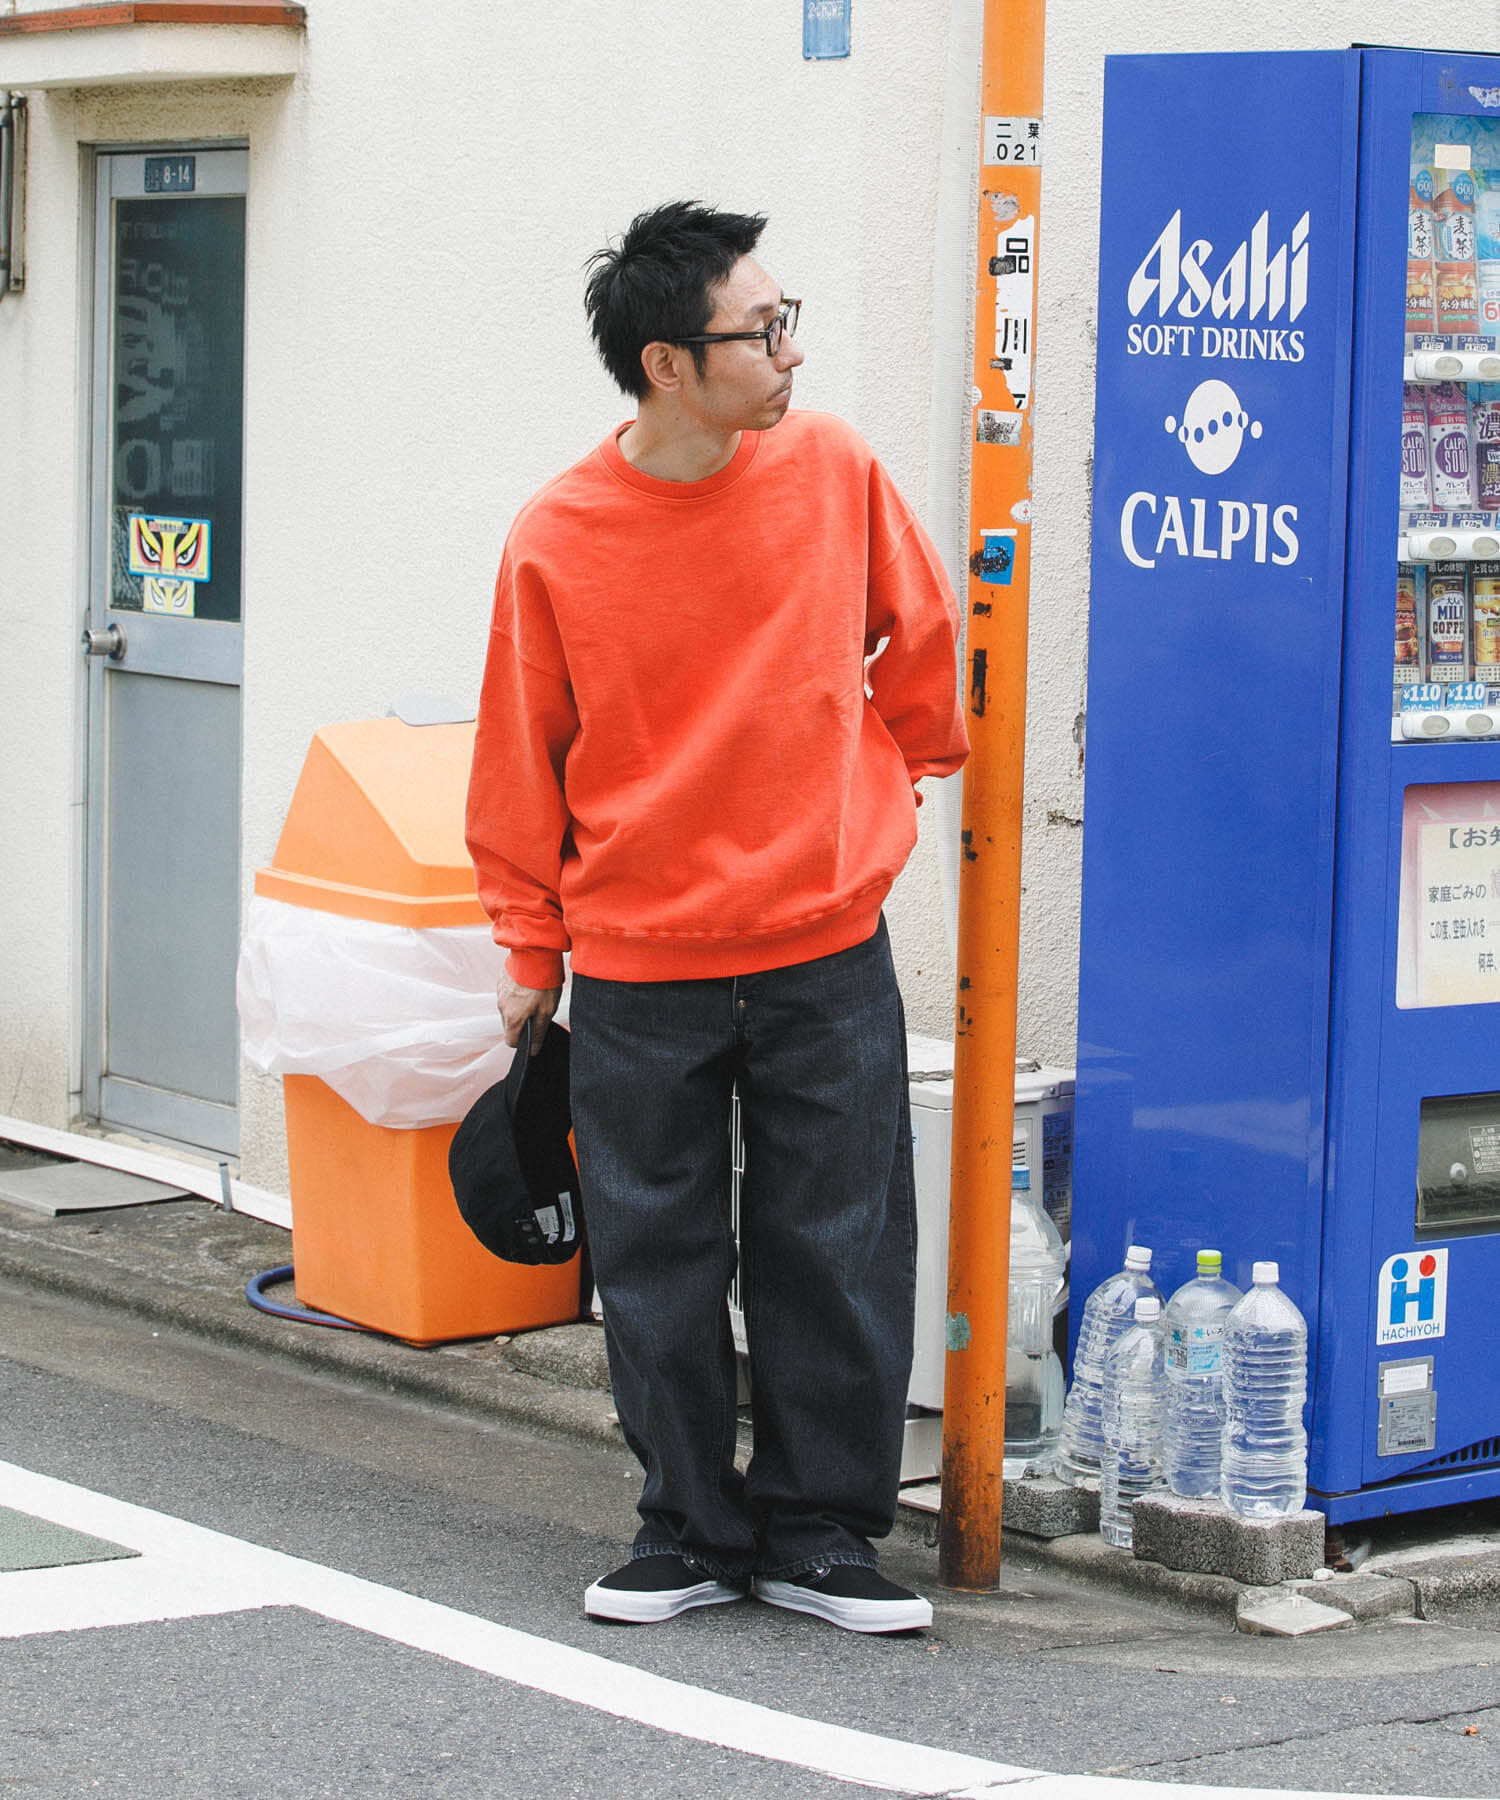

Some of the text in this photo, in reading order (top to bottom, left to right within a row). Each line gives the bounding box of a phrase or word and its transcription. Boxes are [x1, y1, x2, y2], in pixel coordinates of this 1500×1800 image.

[996, 143, 1037, 161] 021
[163, 165, 190, 185] 8-14
[1455, 183, 1472, 194] 600
[1413, 213, 1430, 257] 麦茶
[1453, 215, 1470, 259] 麦茶
[1127, 208, 1311, 324] Asahi
[1127, 323, 1305, 363] SOFT DRINKS
[1120, 491, 1299, 569] CALPIS
[1403, 684, 1441, 702] ¥110
[1448, 683, 1485, 701] ¥110
[1428, 884, 1487, 903] 家庭ごみの
[1382, 1323, 1440, 1340] HACHIYOH
